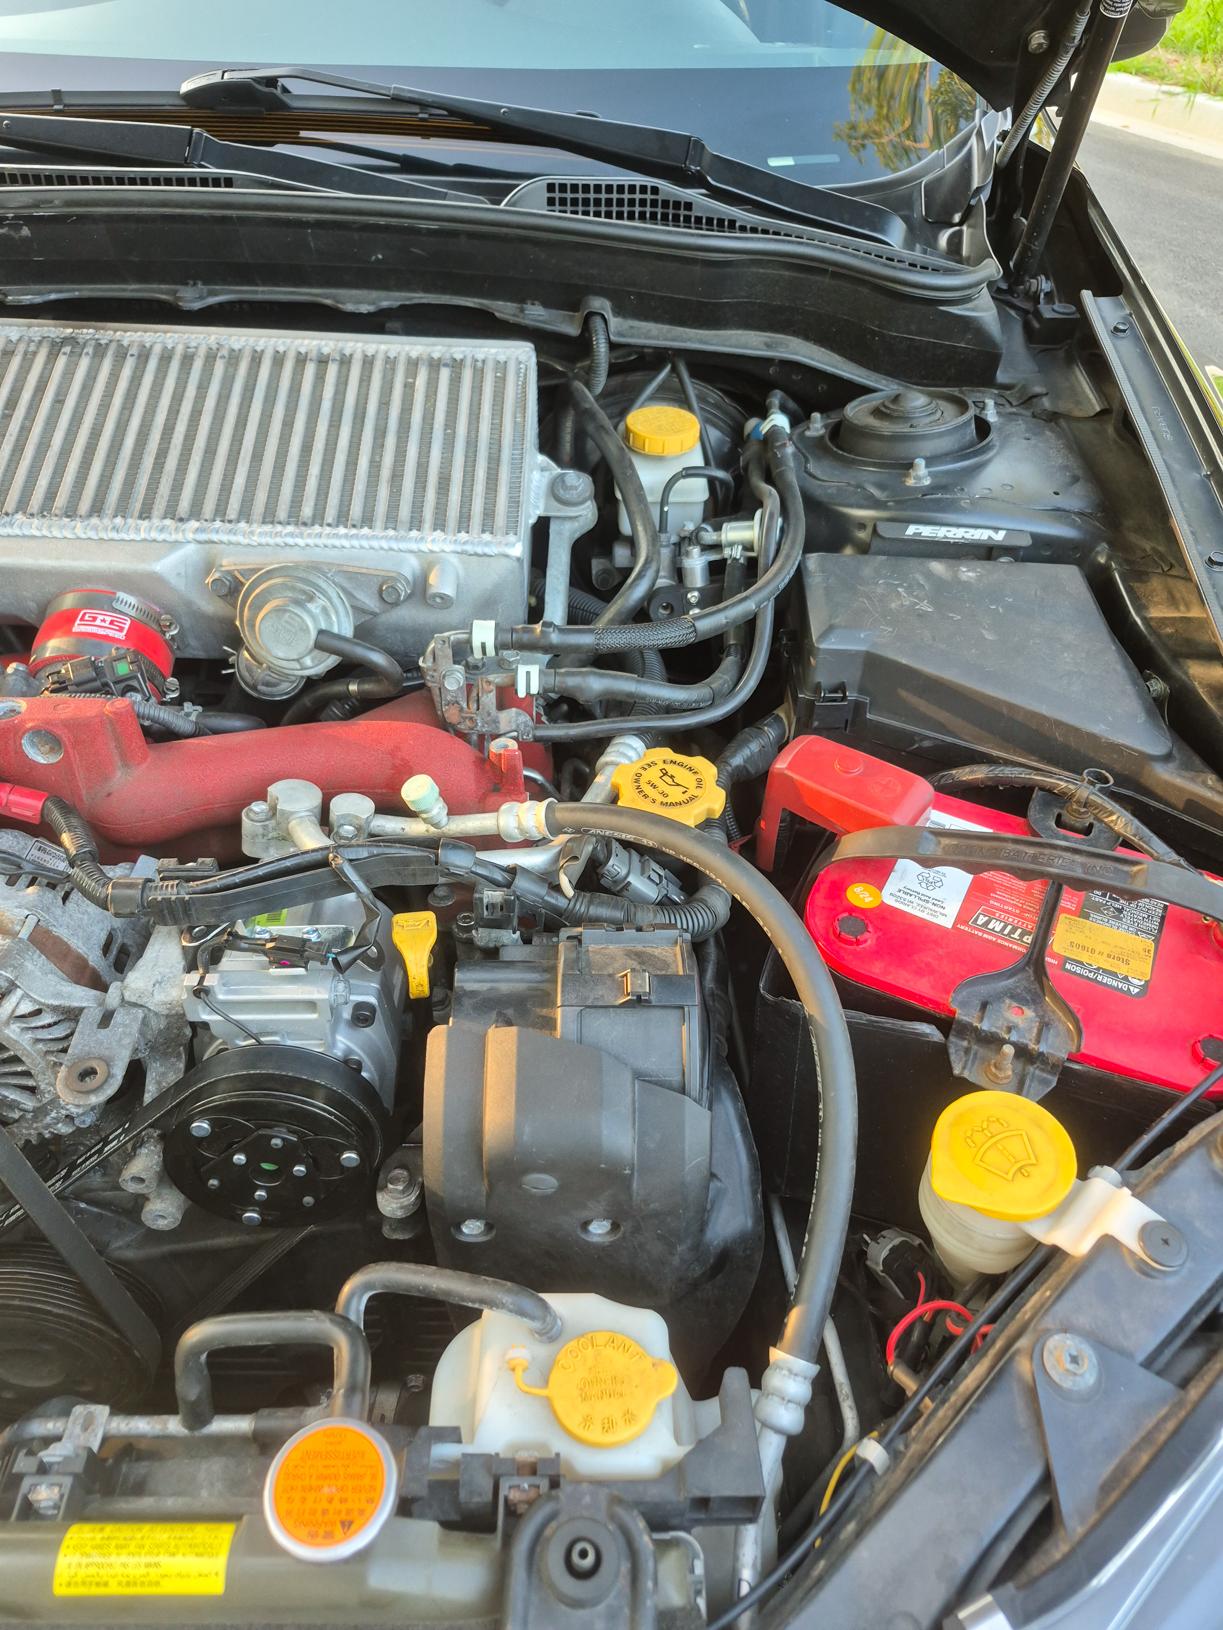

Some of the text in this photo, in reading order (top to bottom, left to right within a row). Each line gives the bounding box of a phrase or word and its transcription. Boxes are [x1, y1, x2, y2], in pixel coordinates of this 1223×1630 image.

[905, 523, 1007, 541] PERRIN
[633, 760, 699, 808] SEE OWNER'S MANUAL
[663, 759, 704, 790] ENGINE OIL
[645, 779, 669, 799] 5W-30
[896, 888, 946, 910] NON-SPILLABLE
[1106, 900, 1122, 908] HELP
[956, 923, 982, 936] BATTERY
[976, 913, 1033, 943] PTIMA
[994, 912, 1035, 930] ATTERIES
[1064, 962, 1128, 990] DANGER/POISON
[558, 1334, 648, 1372] COOLANT
